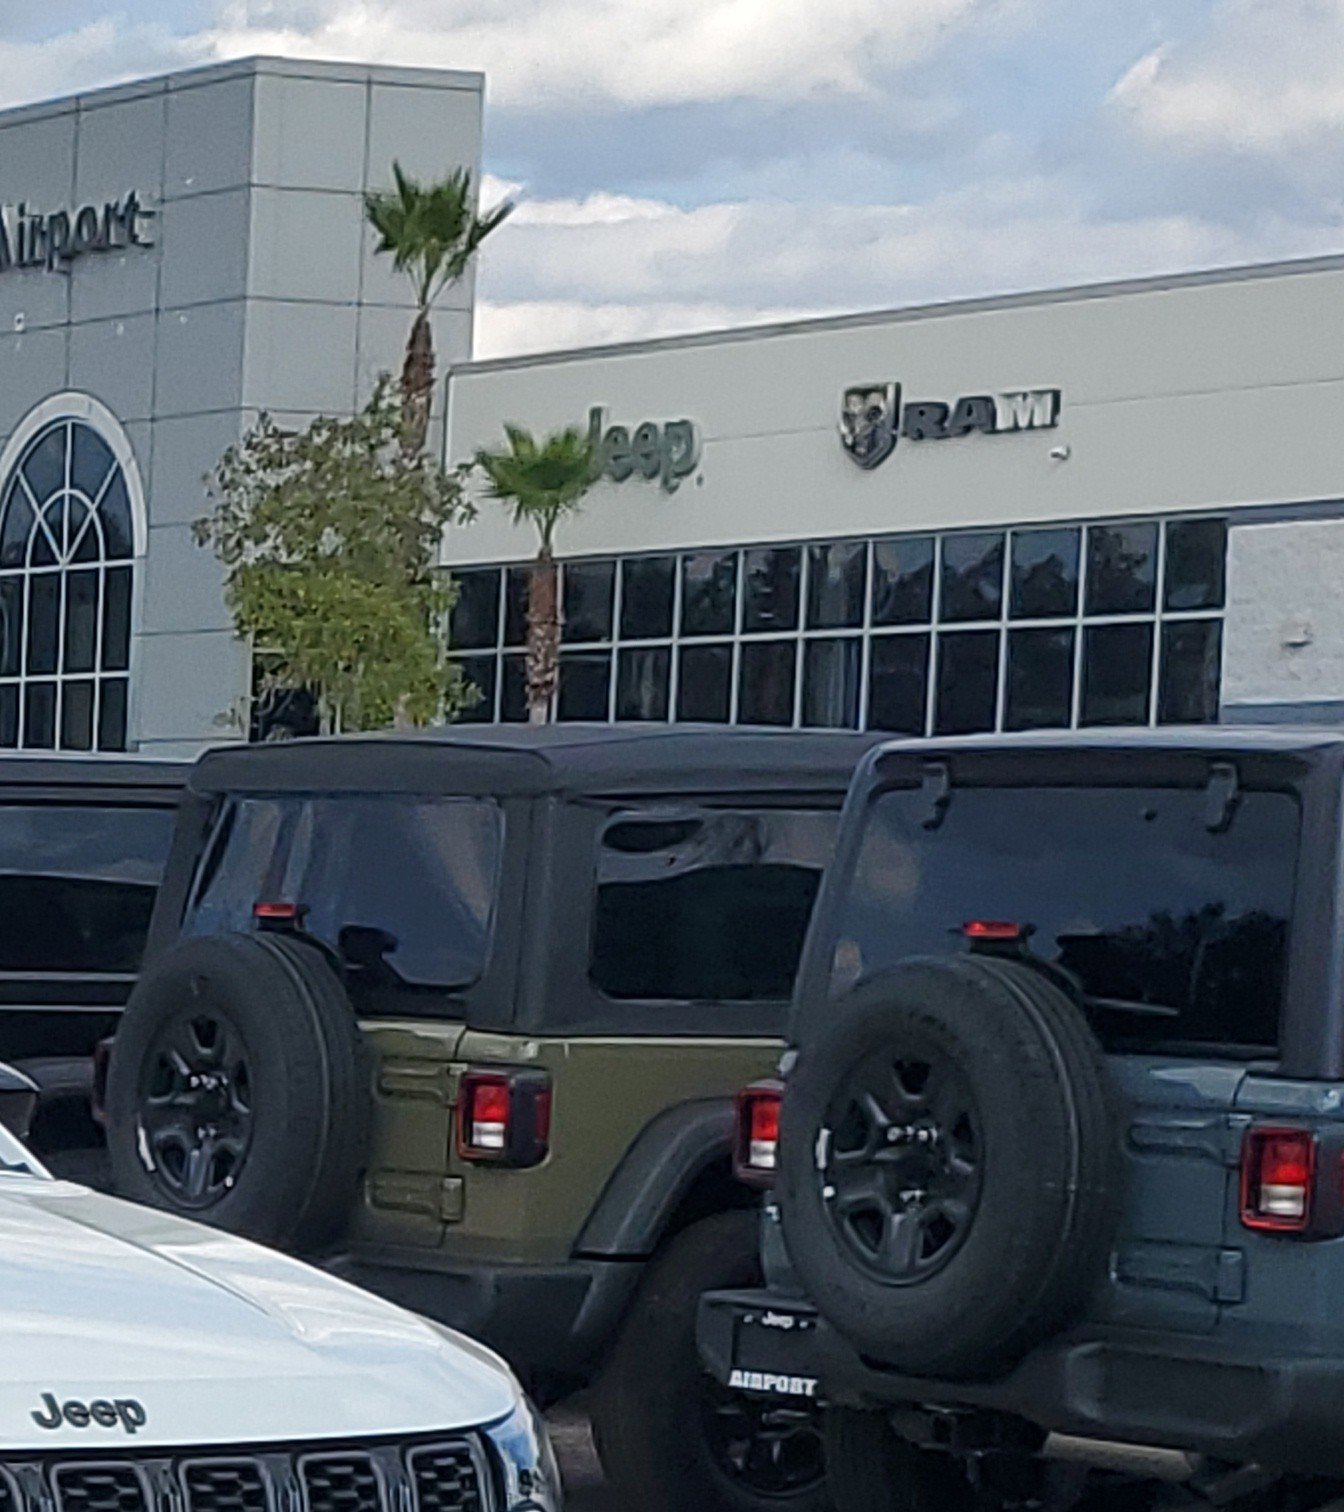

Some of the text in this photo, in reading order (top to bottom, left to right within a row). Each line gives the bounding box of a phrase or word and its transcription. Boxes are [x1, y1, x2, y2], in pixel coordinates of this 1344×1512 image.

[902, 389, 1061, 440] RAM
[729, 1369, 818, 1396] AIRPORT
[30, 1392, 146, 1434] Jeep
